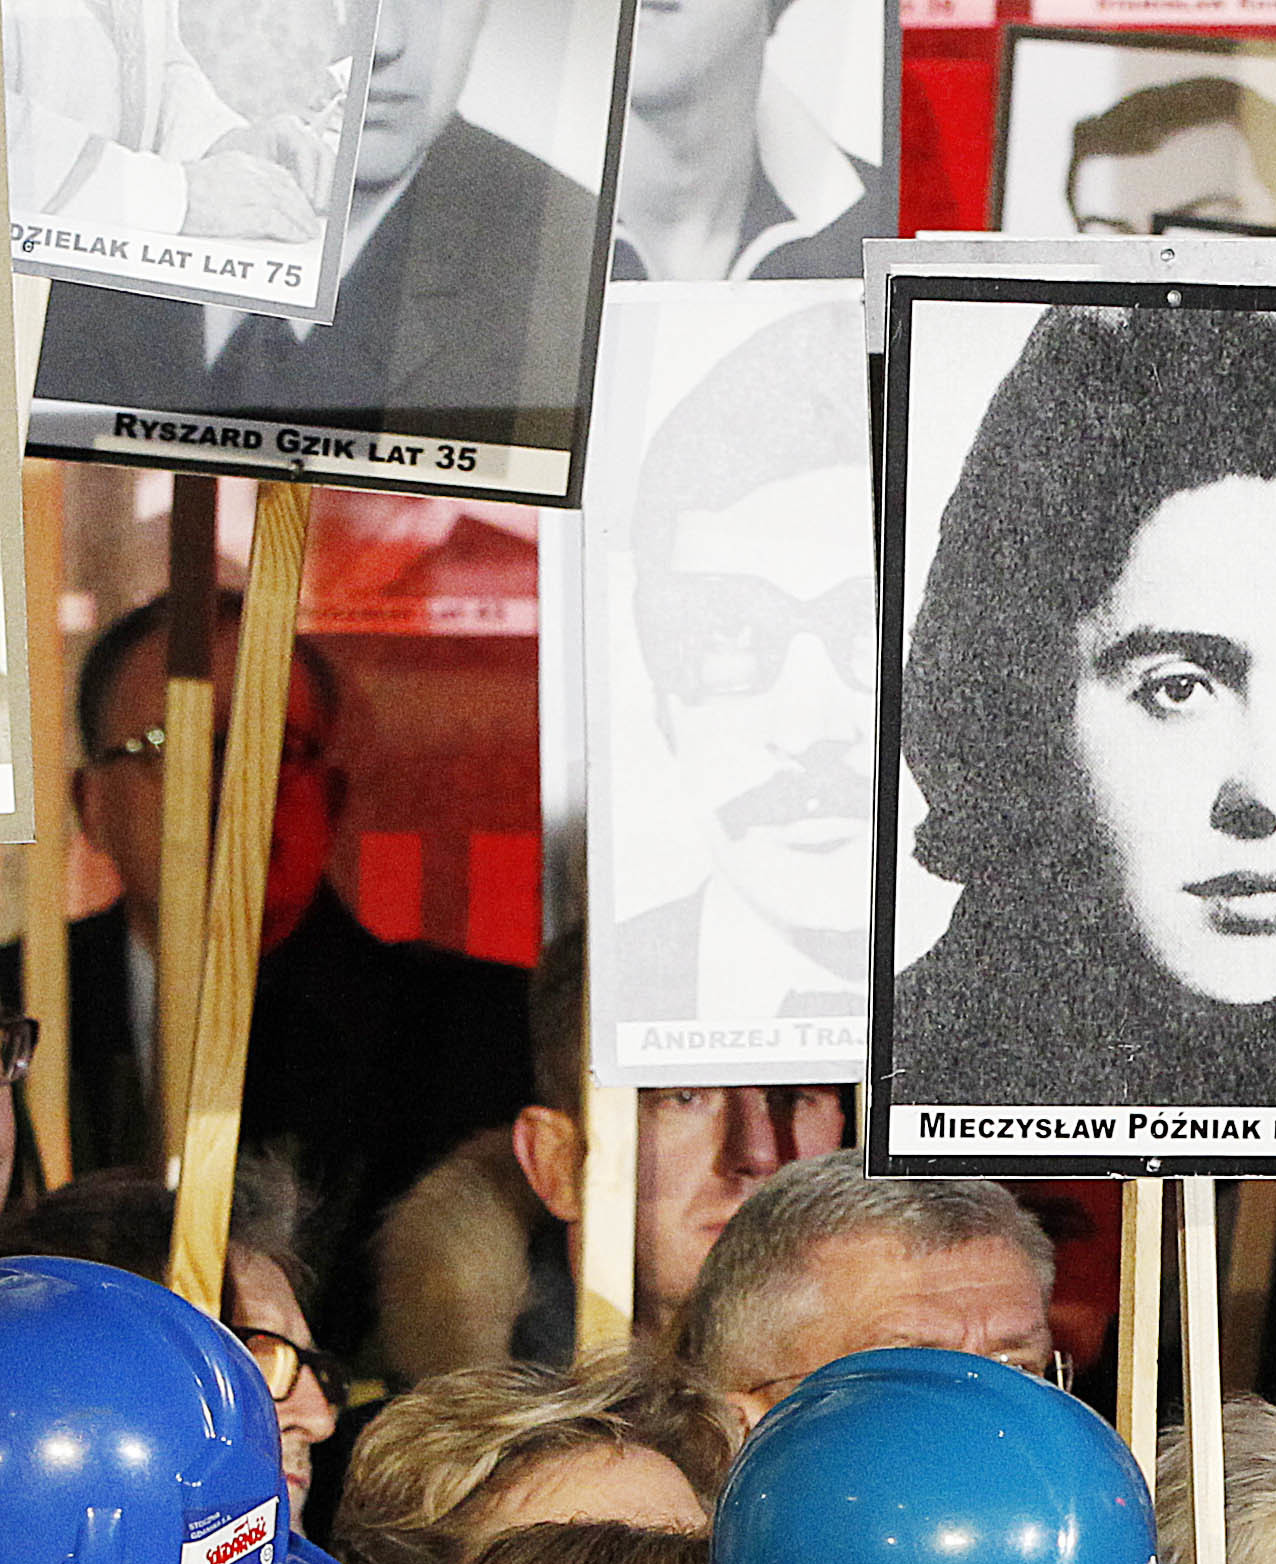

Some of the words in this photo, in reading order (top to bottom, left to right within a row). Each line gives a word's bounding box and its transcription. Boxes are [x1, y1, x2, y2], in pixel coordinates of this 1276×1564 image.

[141, 244, 193, 270] LAT
[203, 255, 255, 281] LAT
[266, 260, 303, 289] 75
[113, 411, 264, 451] RYSZARD
[275, 428, 355, 460] GZIK
[367, 443, 424, 467] LAT
[435, 444, 477, 473] 35
[640, 1025, 782, 1052] ANDRZEJ
[919, 1111, 1118, 1140] MIECZYSŁAW
[1127, 1111, 1263, 1141] PÓŹNIAK
